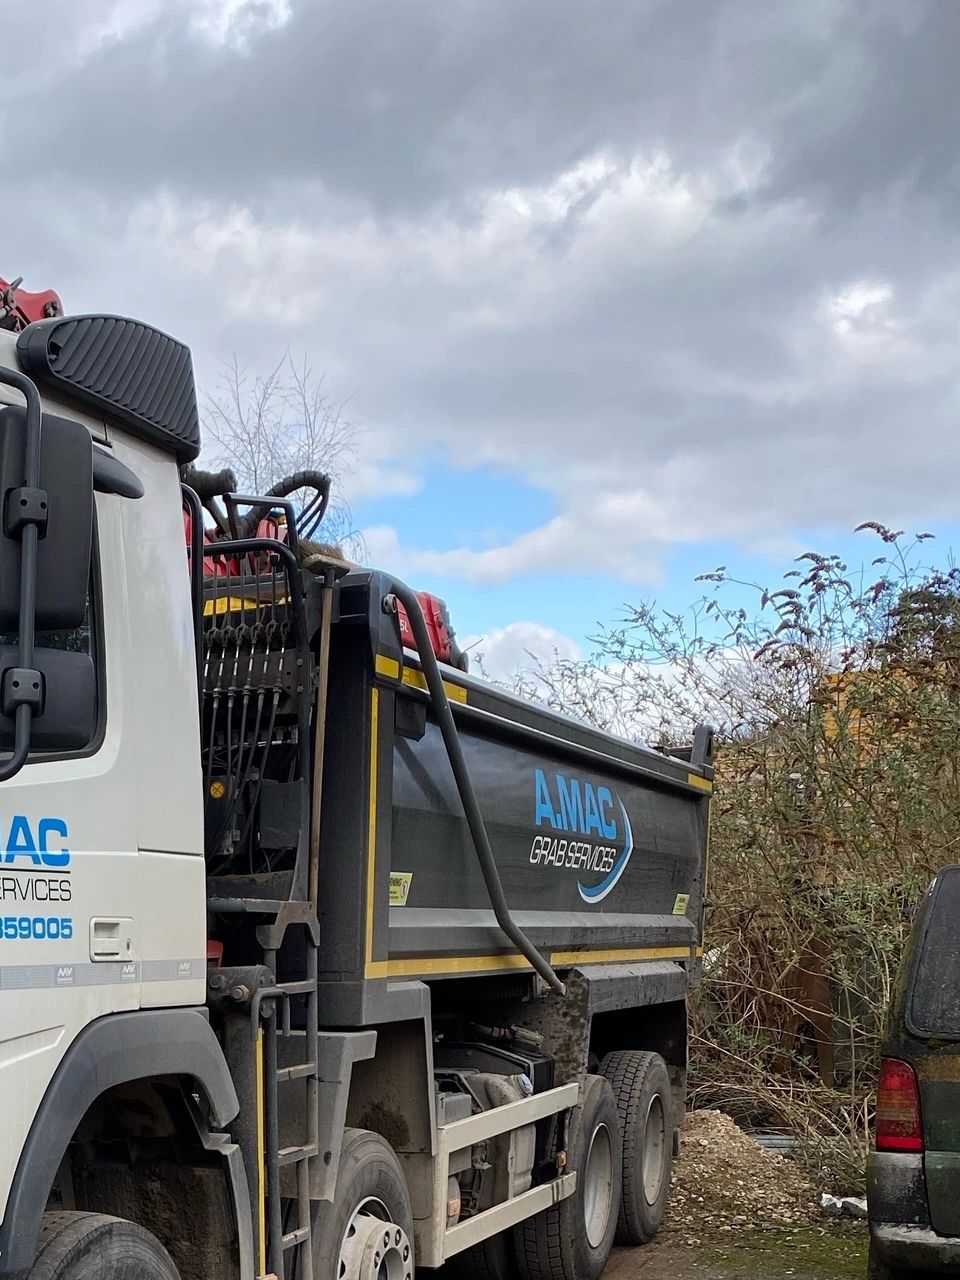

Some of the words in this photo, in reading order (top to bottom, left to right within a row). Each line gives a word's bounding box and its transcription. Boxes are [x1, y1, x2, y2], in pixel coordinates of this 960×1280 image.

[535, 768, 617, 840] A.MAC
[529, 836, 567, 867] GRAB
[565, 841, 617, 873] SERVICES
